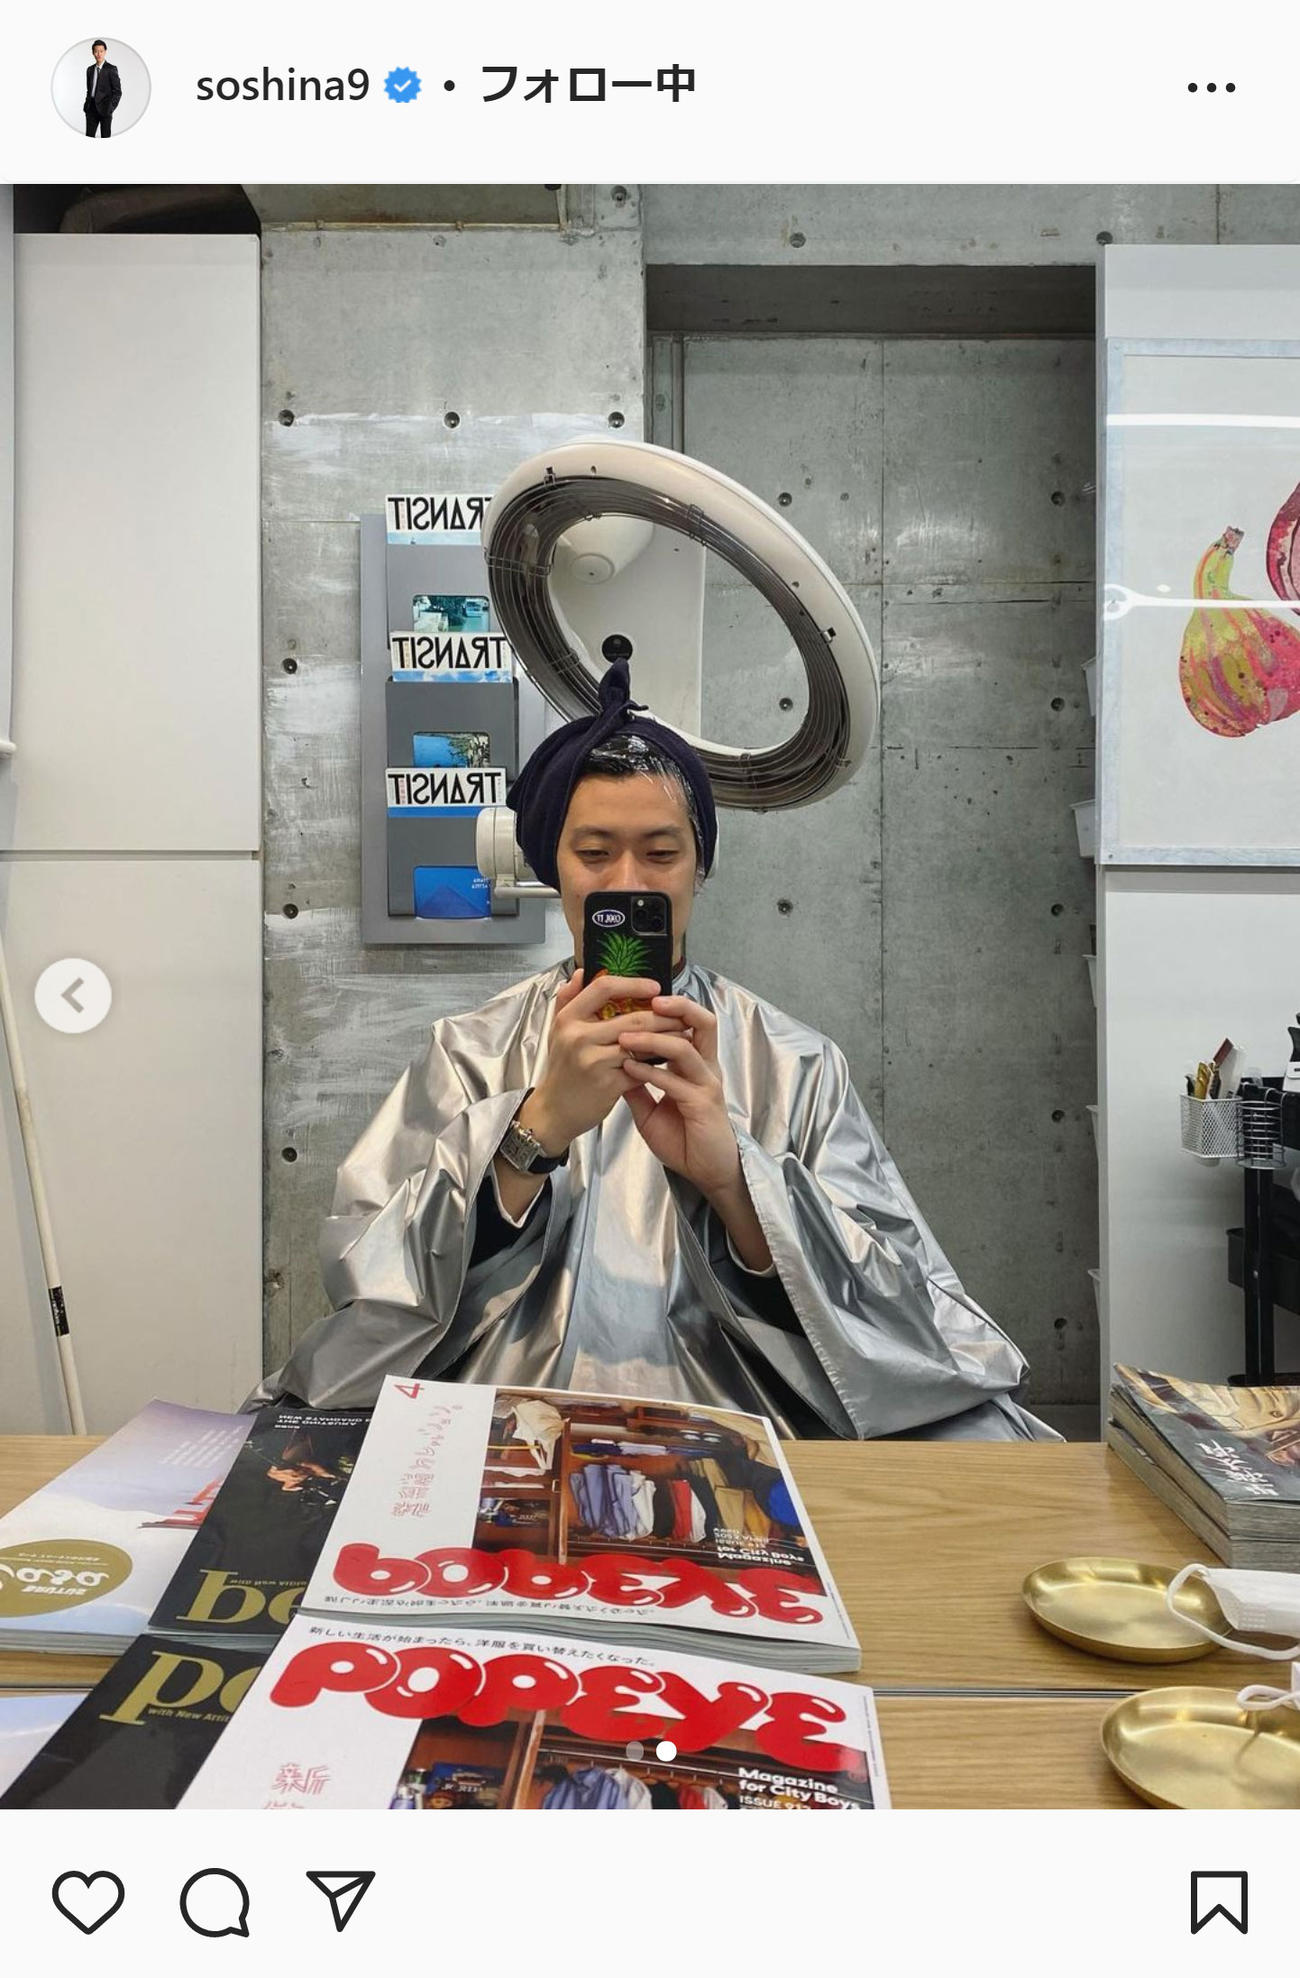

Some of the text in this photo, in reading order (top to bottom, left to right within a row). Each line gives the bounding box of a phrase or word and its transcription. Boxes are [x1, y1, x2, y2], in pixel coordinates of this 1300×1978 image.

[148, 1706, 174, 1718] with
[175, 1709, 202, 1720] New
[269, 1641, 866, 1772] POPEYE
[738, 1766, 839, 1794] Magazine
[738, 1779, 861, 1809] for City Boys
[739, 1795, 781, 1809] ISSUE
